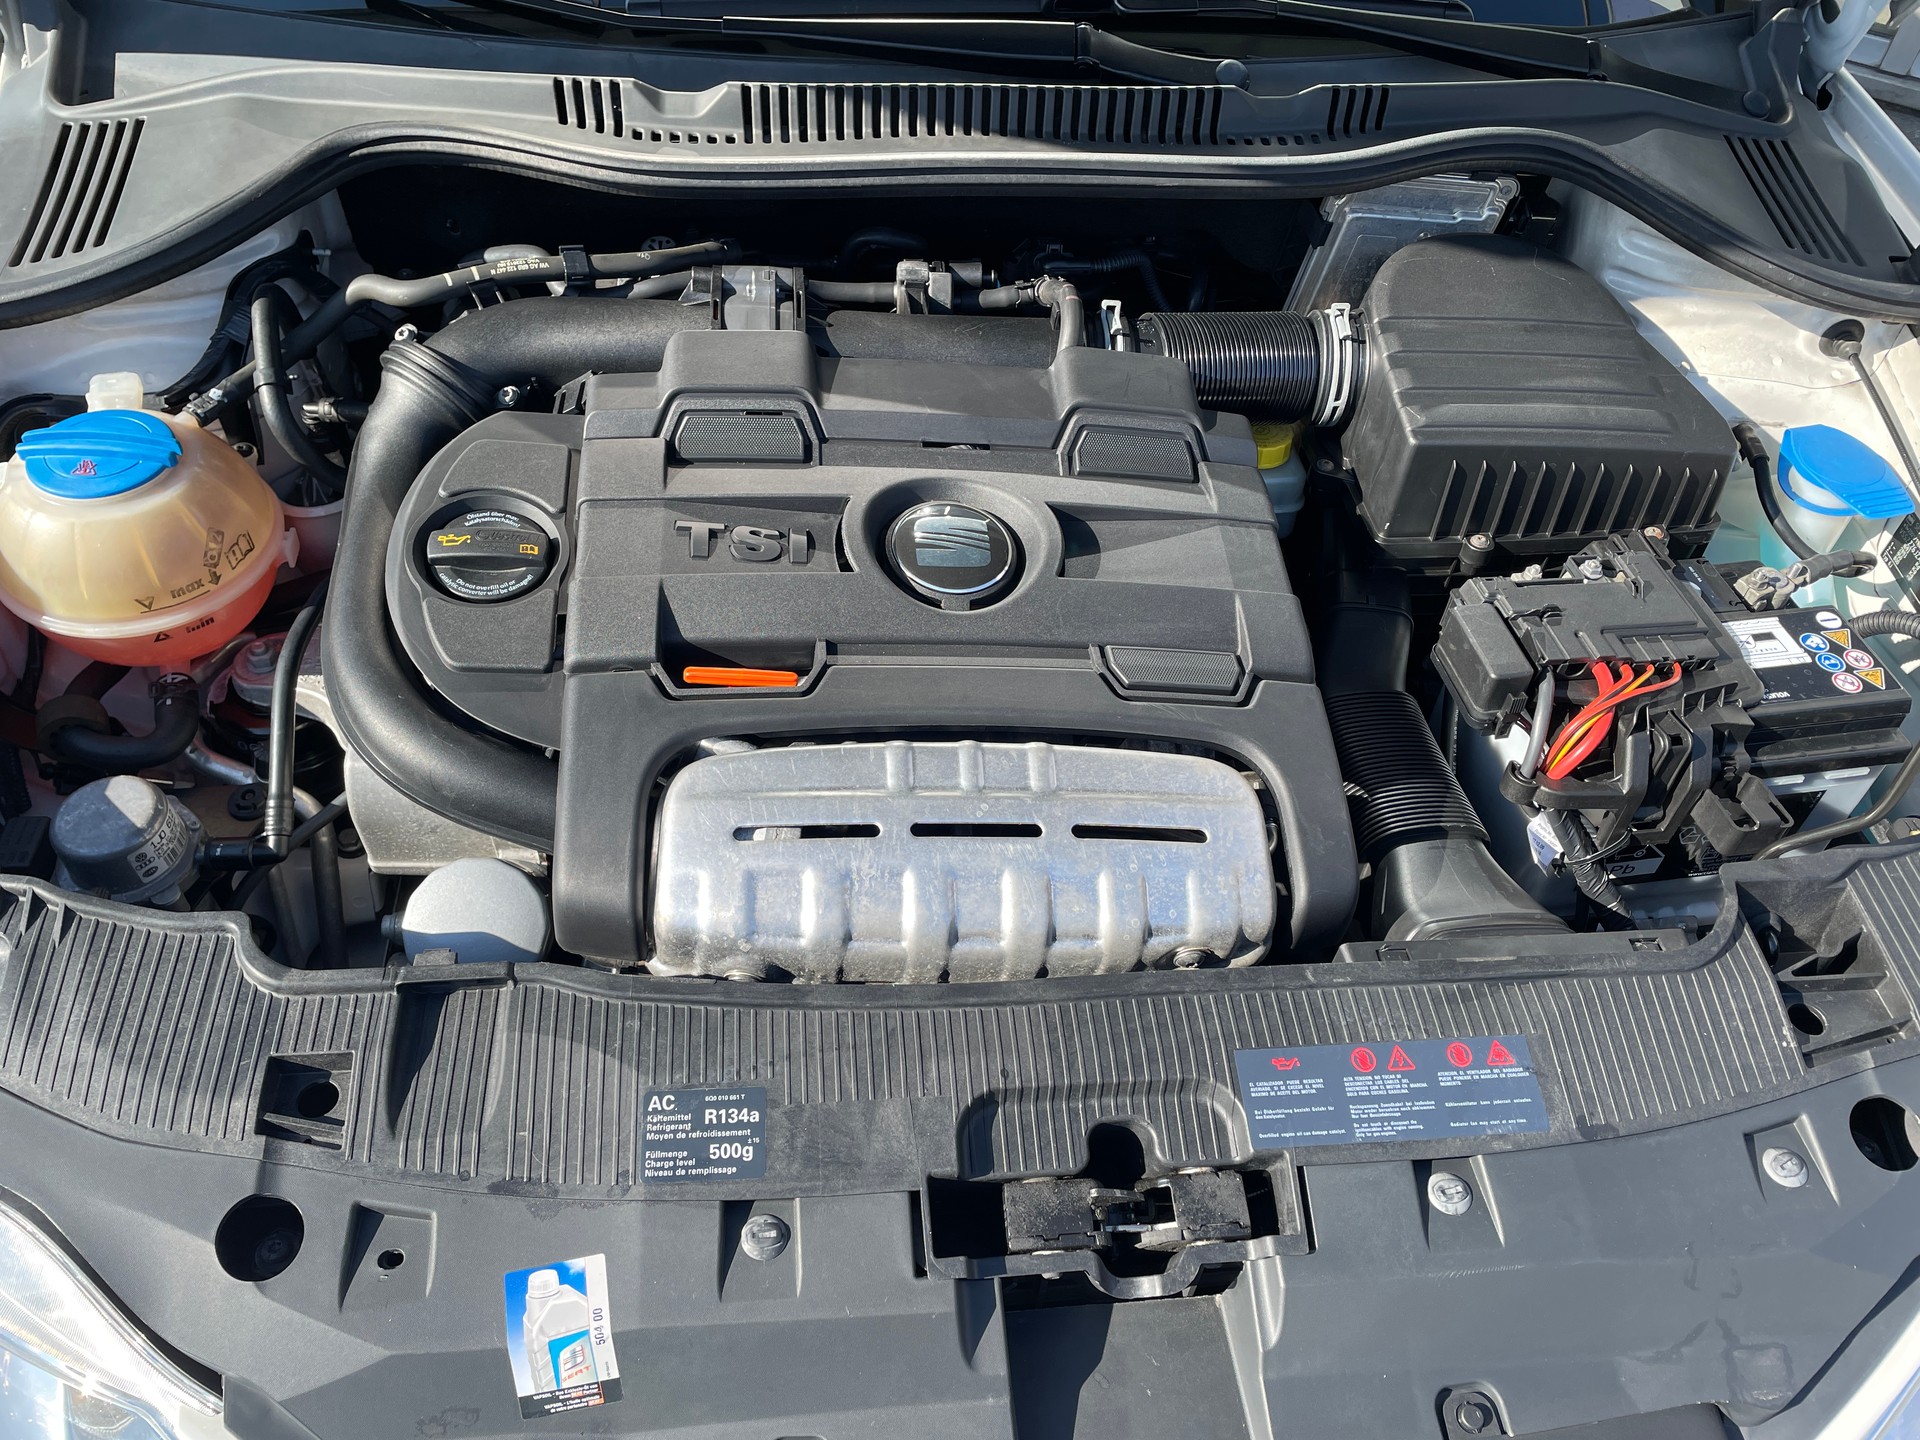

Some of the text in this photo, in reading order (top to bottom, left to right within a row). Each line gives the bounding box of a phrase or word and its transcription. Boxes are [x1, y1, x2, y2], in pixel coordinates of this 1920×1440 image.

[674, 520, 809, 564] TSI
[170, 578, 205, 598] max
[440, 573, 458, 589] catalytic
[458, 587, 486, 596] converter
[1611, 864, 1636, 874] Pb
[647, 1113, 692, 1122] Kältemittel
[704, 1108, 760, 1124] R134a
[646, 1123, 692, 1132] Refrigerant
[646, 1132, 674, 1141] Moyen
[688, 1129, 750, 1138] refroidissement
[646, 1151, 688, 1160] Füllmenge
[709, 1143, 754, 1161] 500g
[645, 1158, 696, 1169] Charge level
[644, 1169, 673, 1177] Niveau
[688, 1166, 737, 1176] remplissage
[593, 1307, 606, 1345] 504 00
